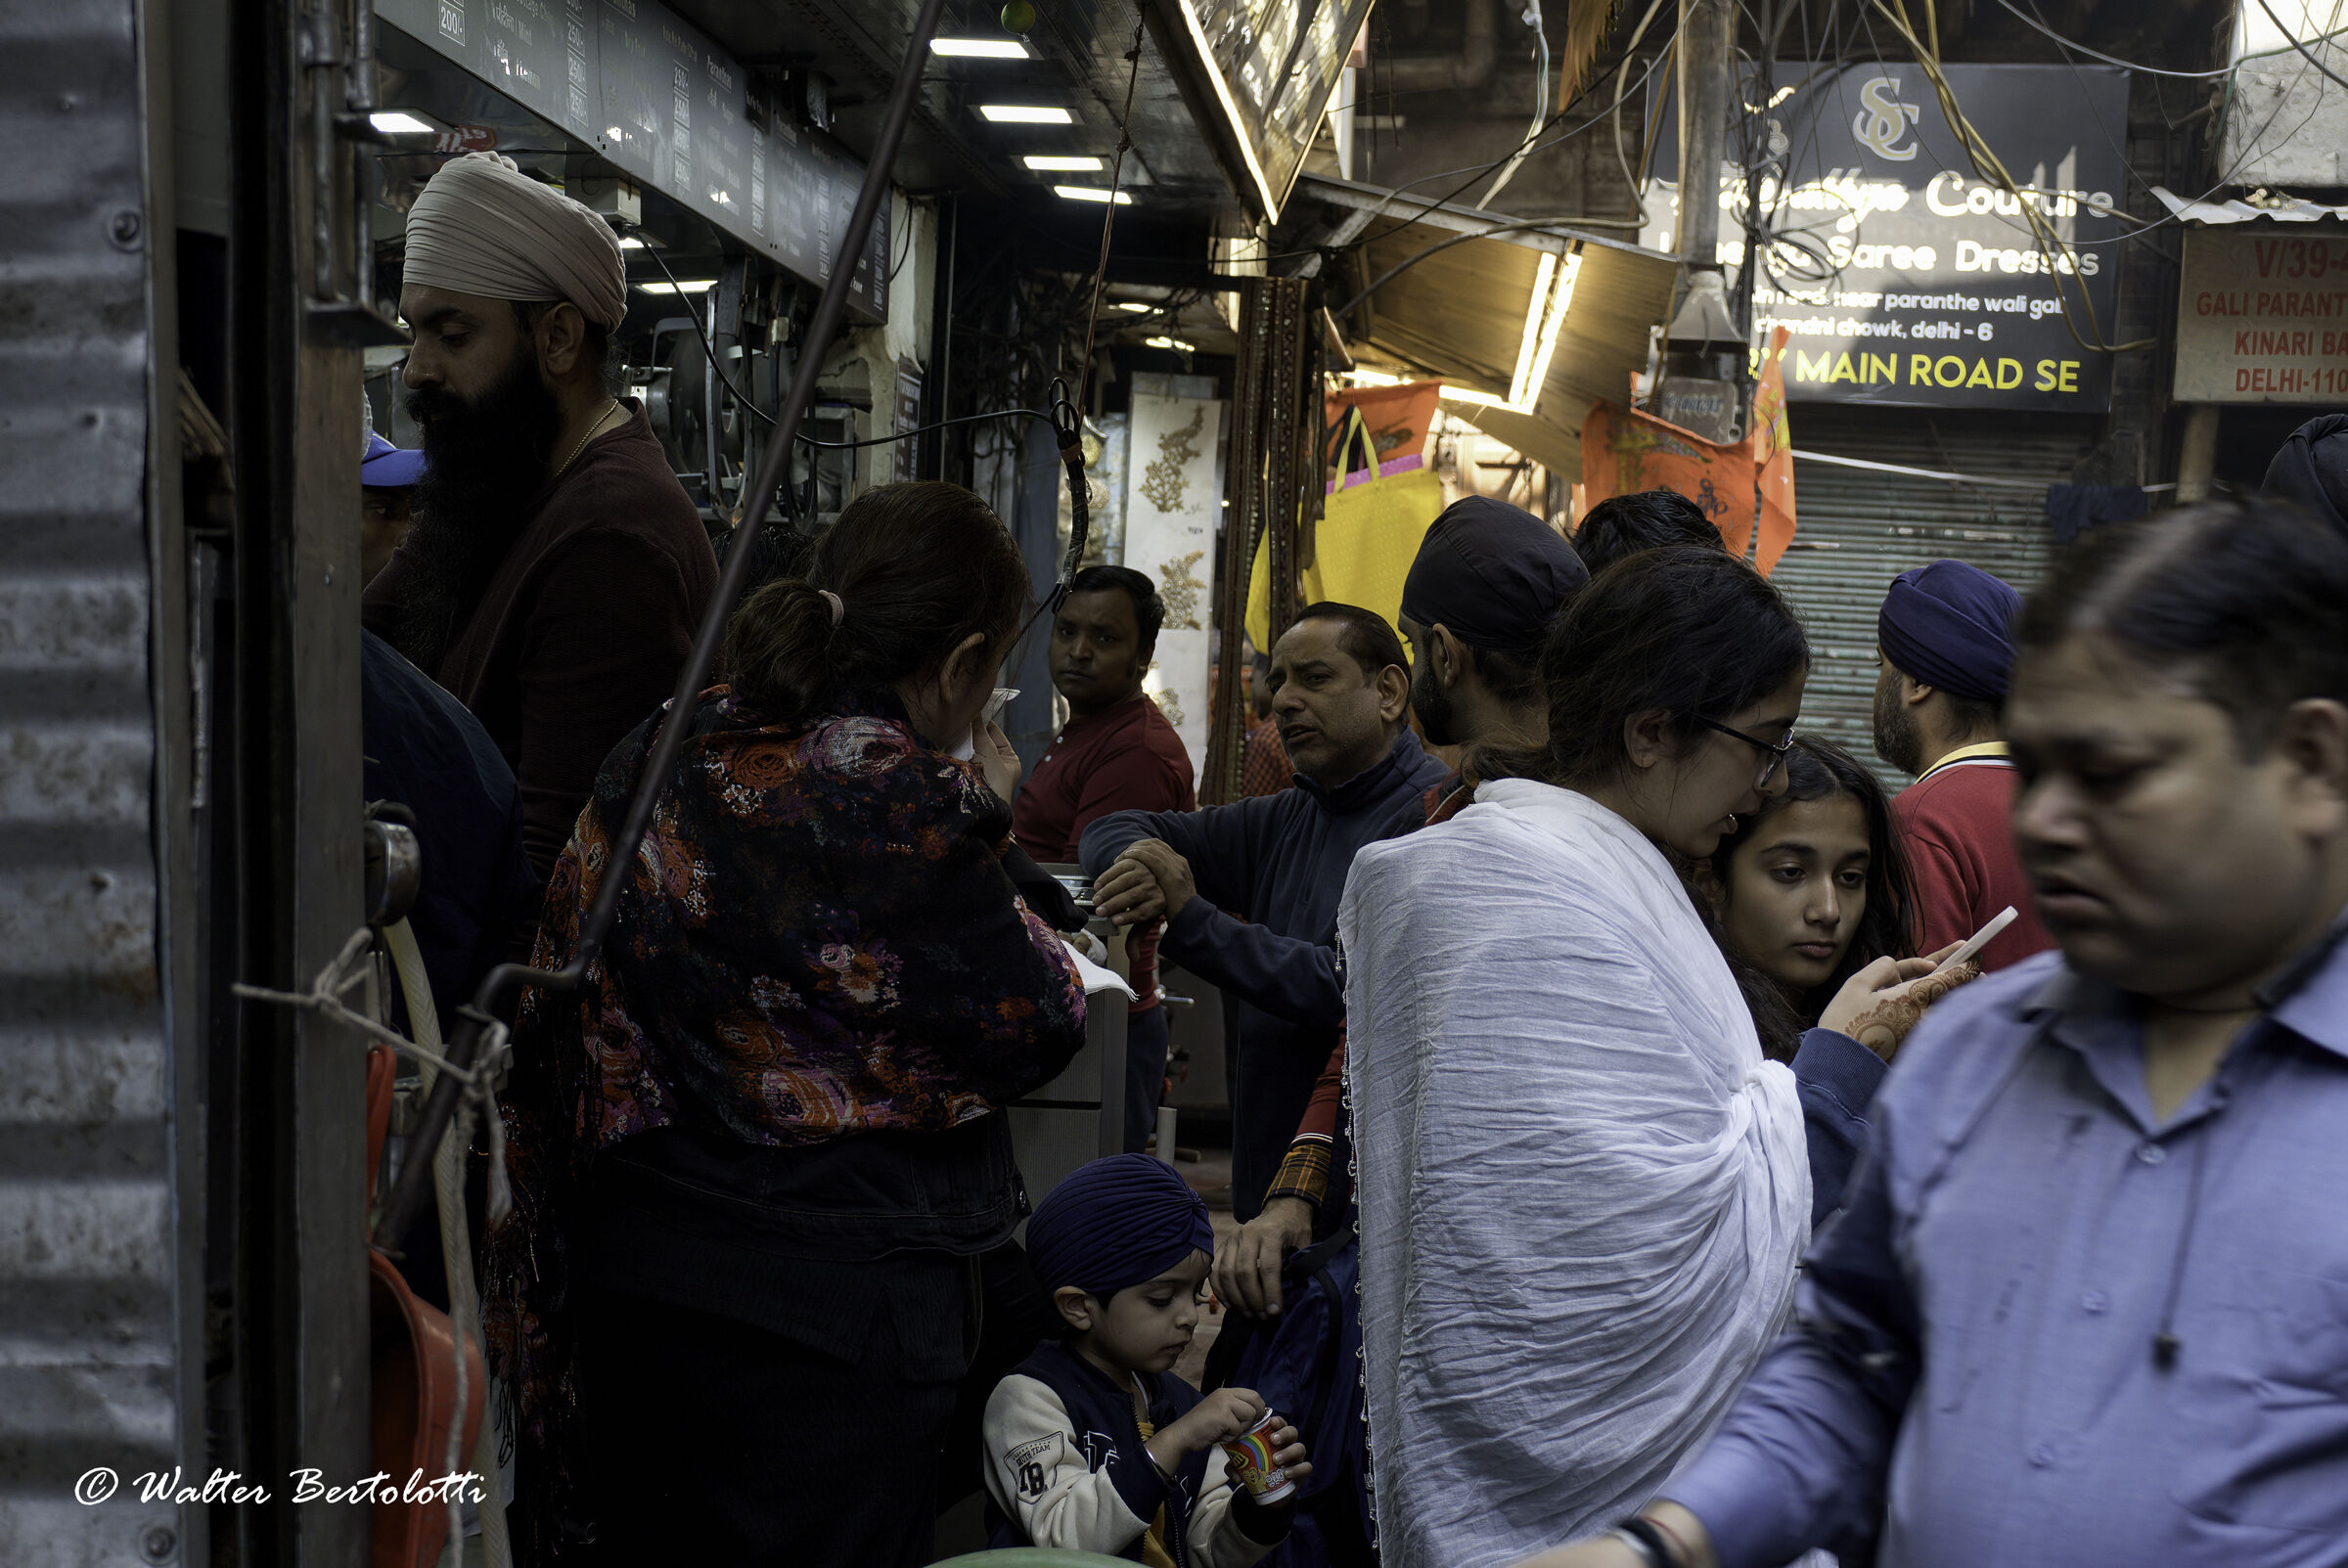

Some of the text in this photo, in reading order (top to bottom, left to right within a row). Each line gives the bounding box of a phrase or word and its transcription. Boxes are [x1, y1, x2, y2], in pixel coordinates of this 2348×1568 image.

[440, 6, 463, 36] 200/-
[1925, 170, 2113, 218] Couture
[1827, 235, 1936, 271] Saree
[1955, 240, 2100, 276] Dresses
[1884, 292, 1979, 312] paranthe
[1984, 295, 2027, 312] wali
[2196, 291, 2348, 317] GALI PARANT
[1836, 317, 1907, 338] chowk,
[1911, 321, 1961, 339] delhi
[1977, 322, 1993, 341] 6
[2234, 331, 2348, 356] KINARI BA
[1795, 349, 1898, 384] MAIN
[1909, 353, 2024, 390] ROAD
[2034, 359, 2080, 392] SE
[1031, 1444, 1051, 1456] TEAM
